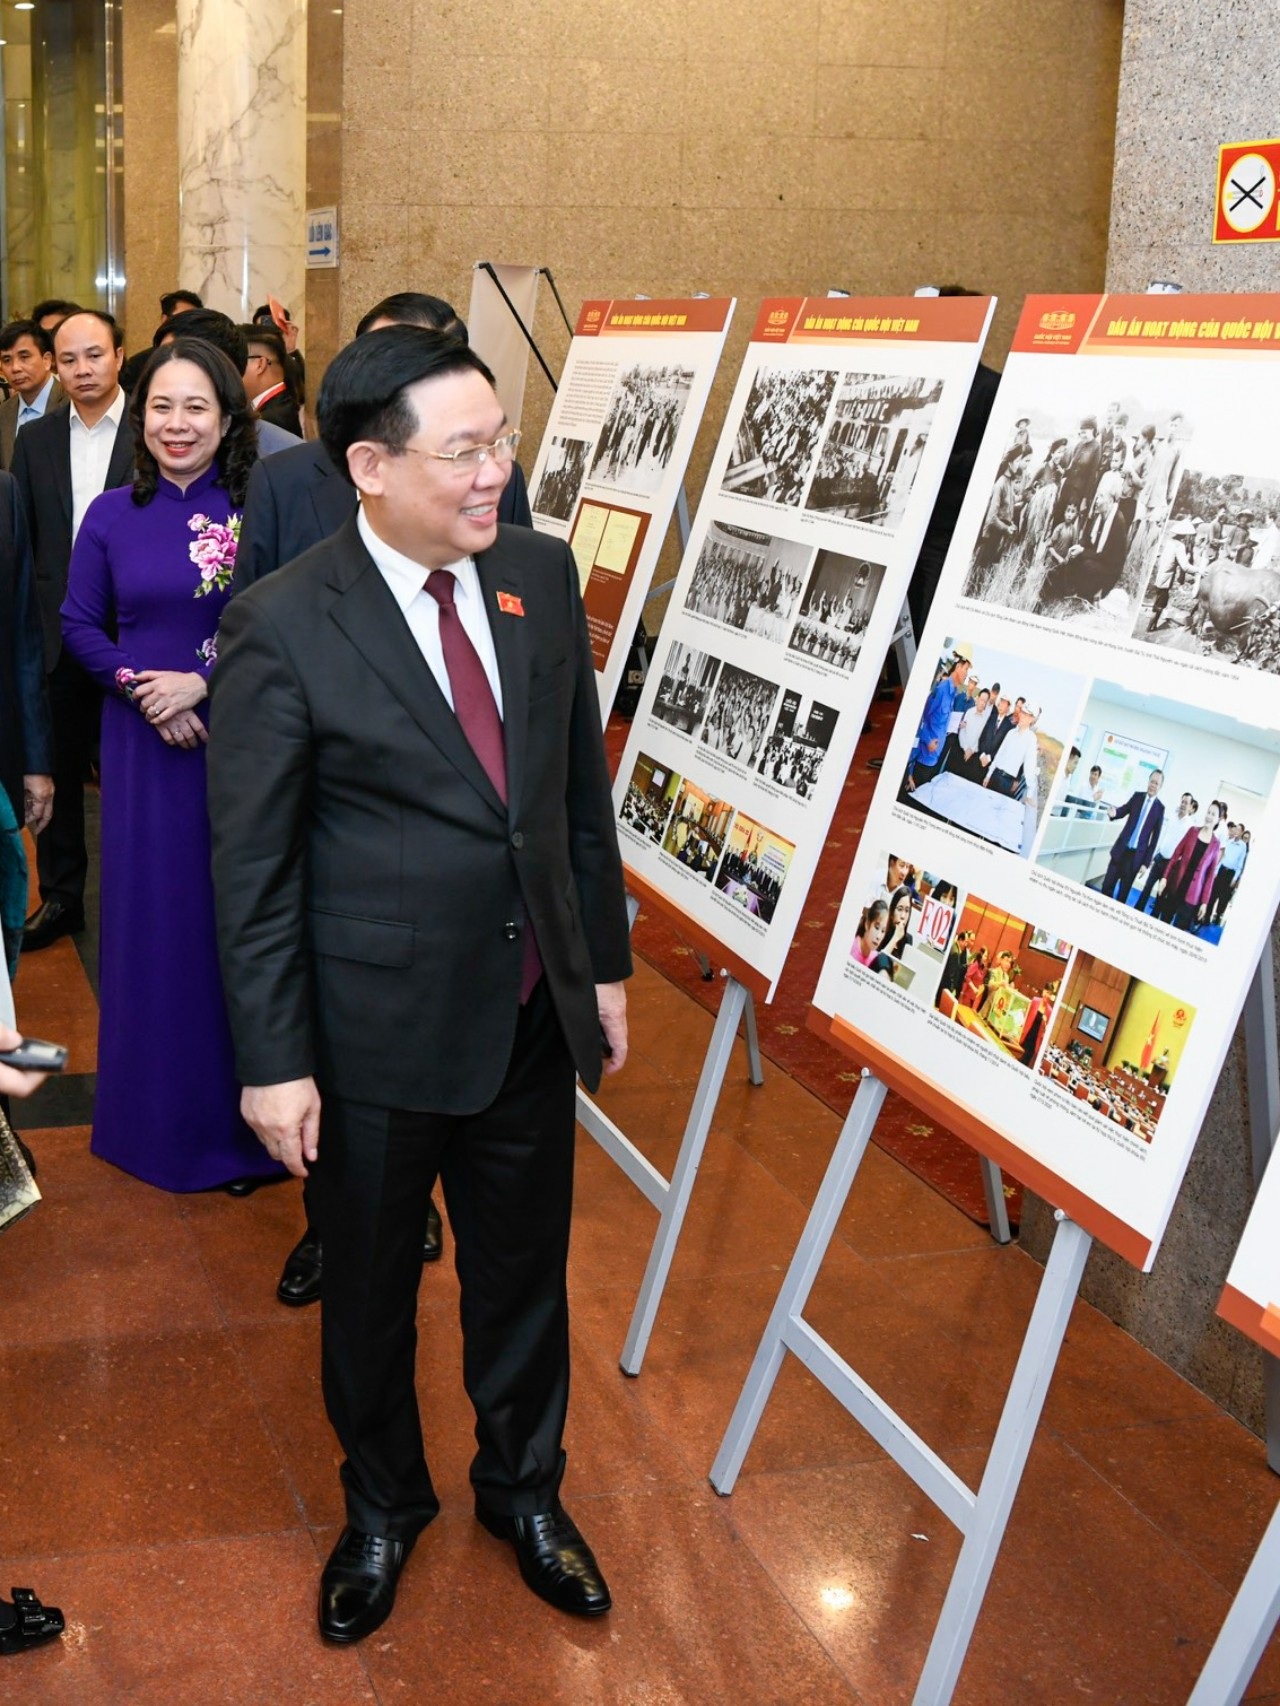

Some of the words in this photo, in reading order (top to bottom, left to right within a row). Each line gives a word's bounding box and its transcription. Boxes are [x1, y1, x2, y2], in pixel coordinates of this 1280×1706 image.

[1107, 315, 1129, 336] DẤU
[1126, 315, 1143, 336] ẤN
[1141, 320, 1170, 339] HOẠT
[1168, 319, 1199, 340] ĐỘNG
[1197, 317, 1221, 338] CỦA
[1221, 316, 1252, 340] QUỐC
[1251, 319, 1275, 342] HỘI
